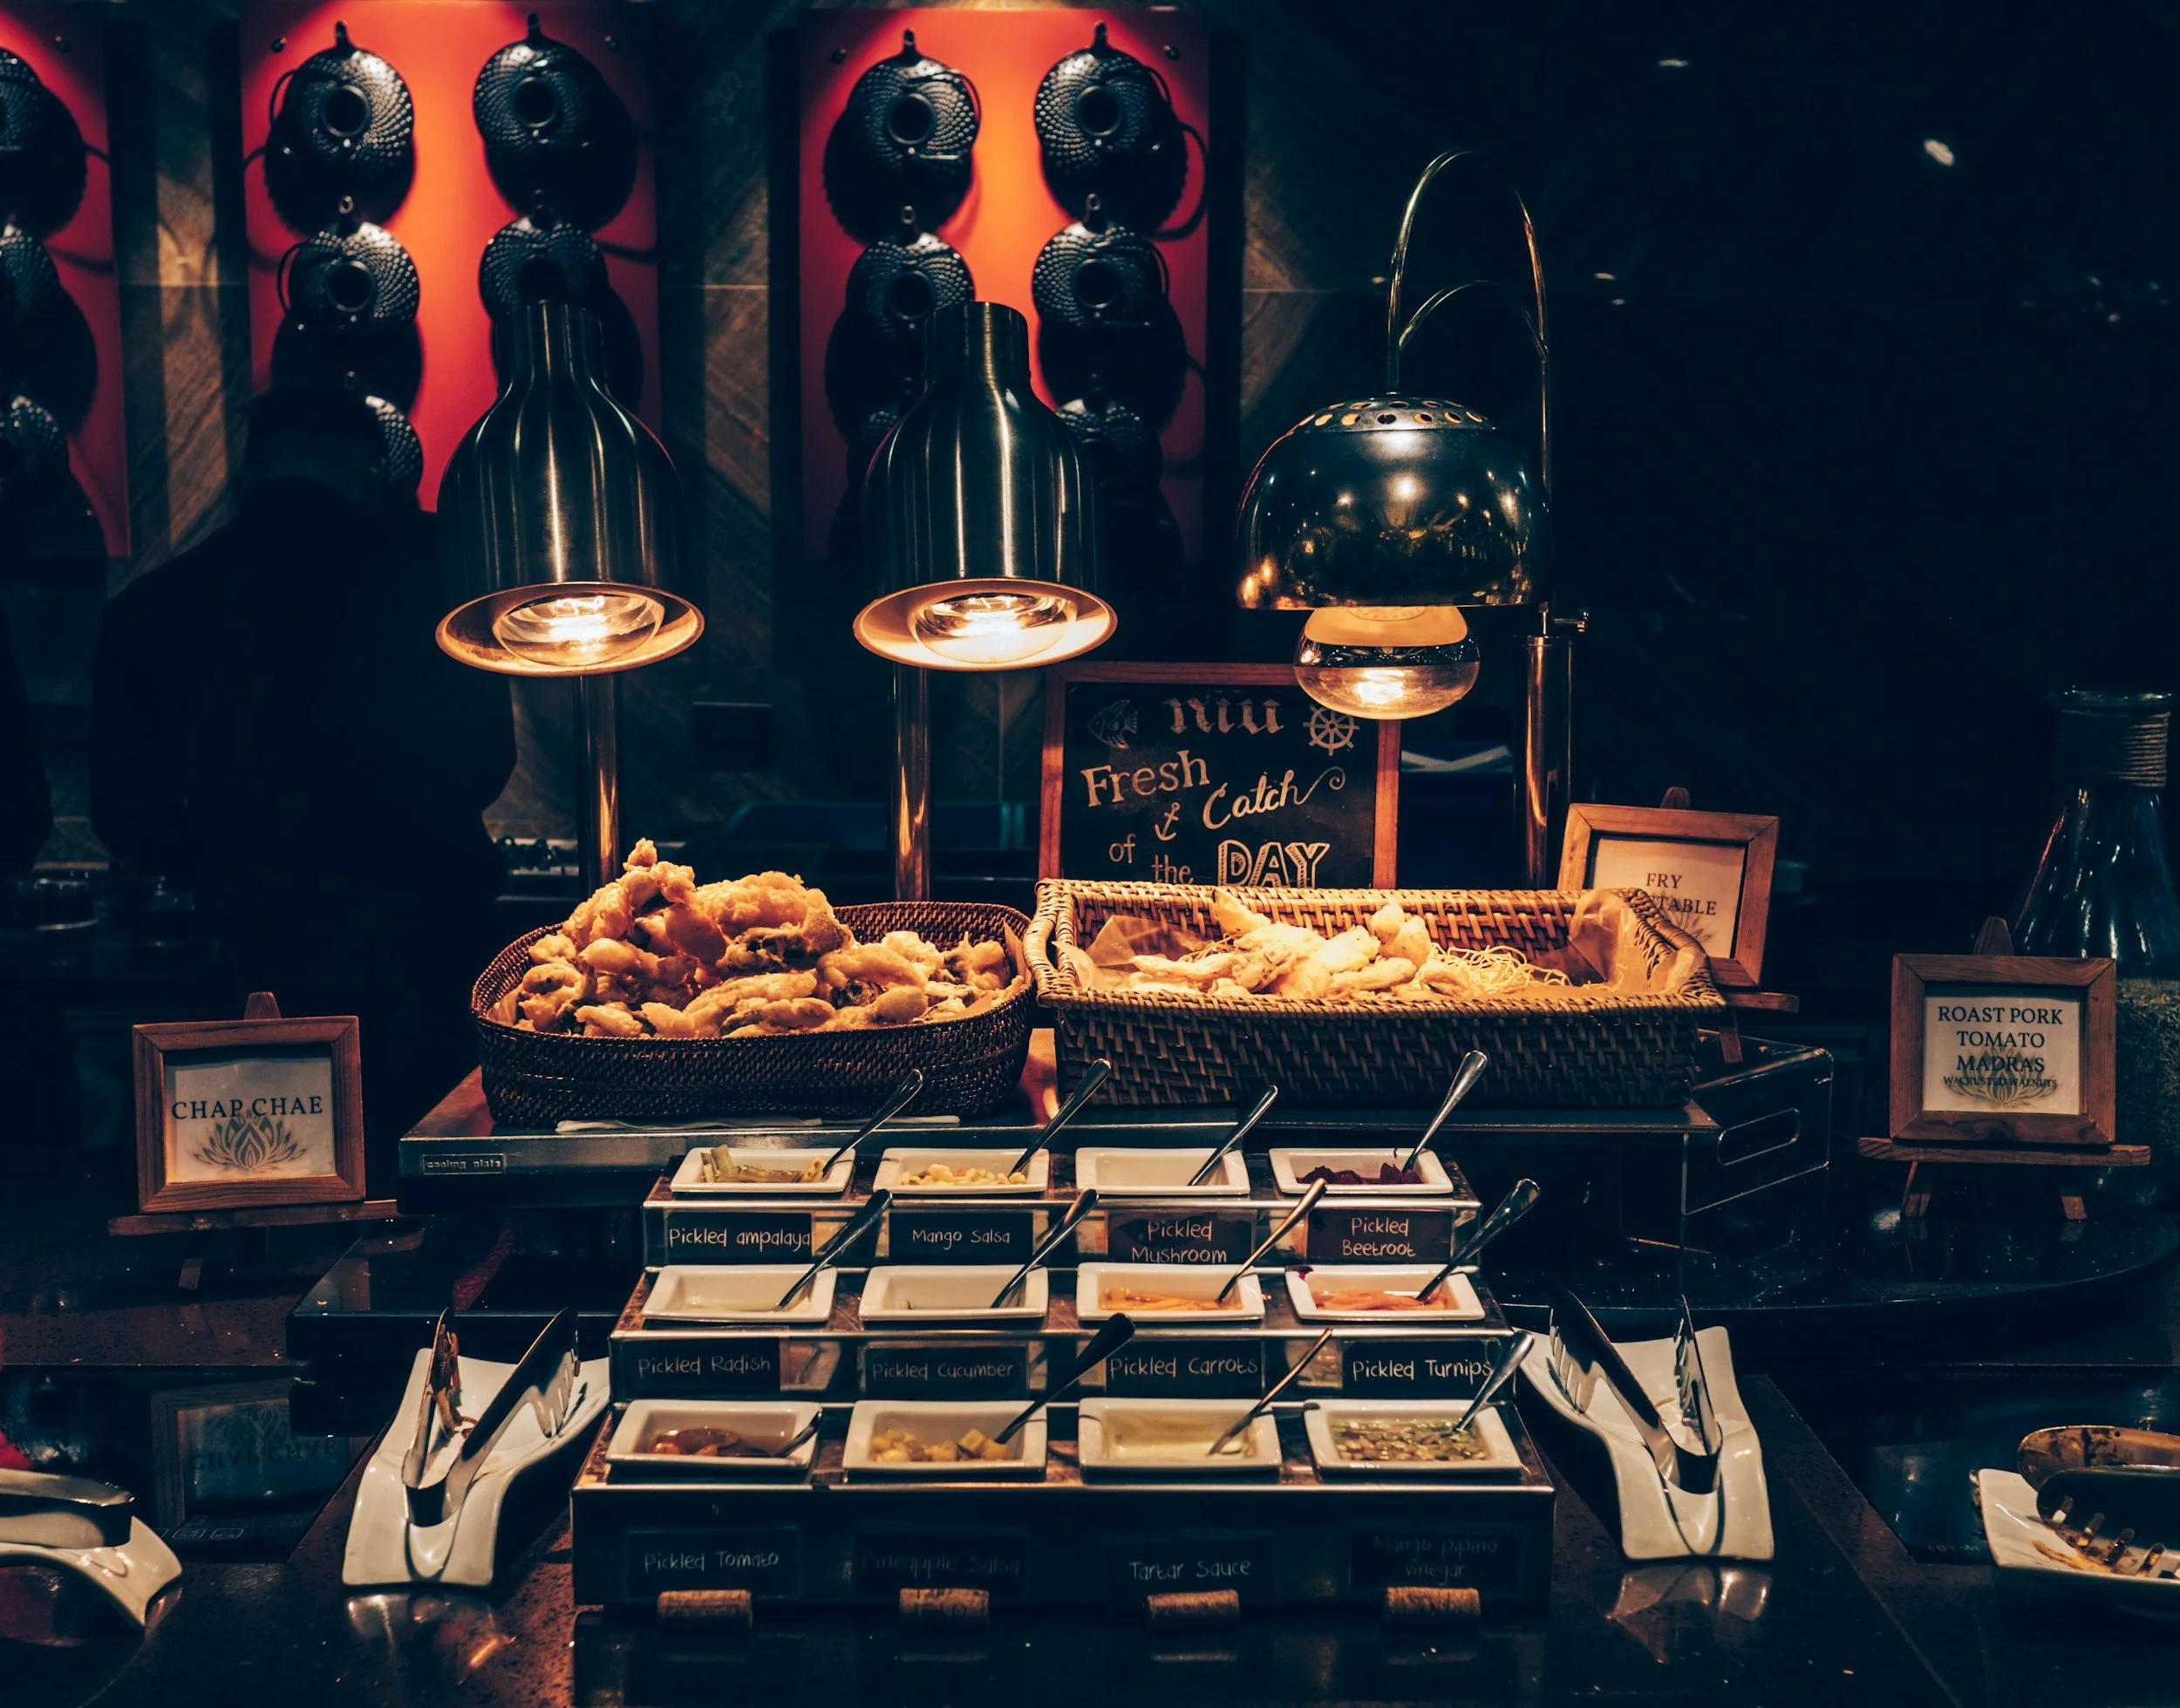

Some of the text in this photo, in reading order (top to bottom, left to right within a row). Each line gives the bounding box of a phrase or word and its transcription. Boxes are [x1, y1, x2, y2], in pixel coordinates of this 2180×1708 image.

[1080, 750, 1210, 807] Fresh
[1202, 766, 1346, 830] Catch
[1109, 833, 1331, 889] of the DAY
[1646, 873, 1683, 888] FRY
[1649, 895, 1717, 915] TABLE
[1938, 1006, 2063, 1024] ROAST PORK
[1957, 1031, 2045, 1048] TOMATO
[1956, 1055, 2045, 1073] MADRAS
[172, 1096, 323, 1119] CHAP CHAE
[912, 1228, 1011, 1250] Mango Salsa
[1148, 1219, 1213, 1242] Pickled
[1351, 1218, 1409, 1238] Pickled
[669, 1228, 811, 1253] Pickled ampalaya
[1342, 1240, 1416, 1257] Beetroot
[1132, 1247, 1227, 1263] Mushroom
[638, 1355, 771, 1375] Pickled Radish
[872, 1363, 1014, 1379] Pickled Cucumber
[1109, 1358, 1258, 1380] Pickled Carrots
[1352, 1358, 1494, 1386] Pickled Turnips
[644, 1550, 780, 1572] Pickled Tomato
[1128, 1559, 1252, 1582] Tartar Sauce
[1405, 1562, 1466, 1587] vinegar
